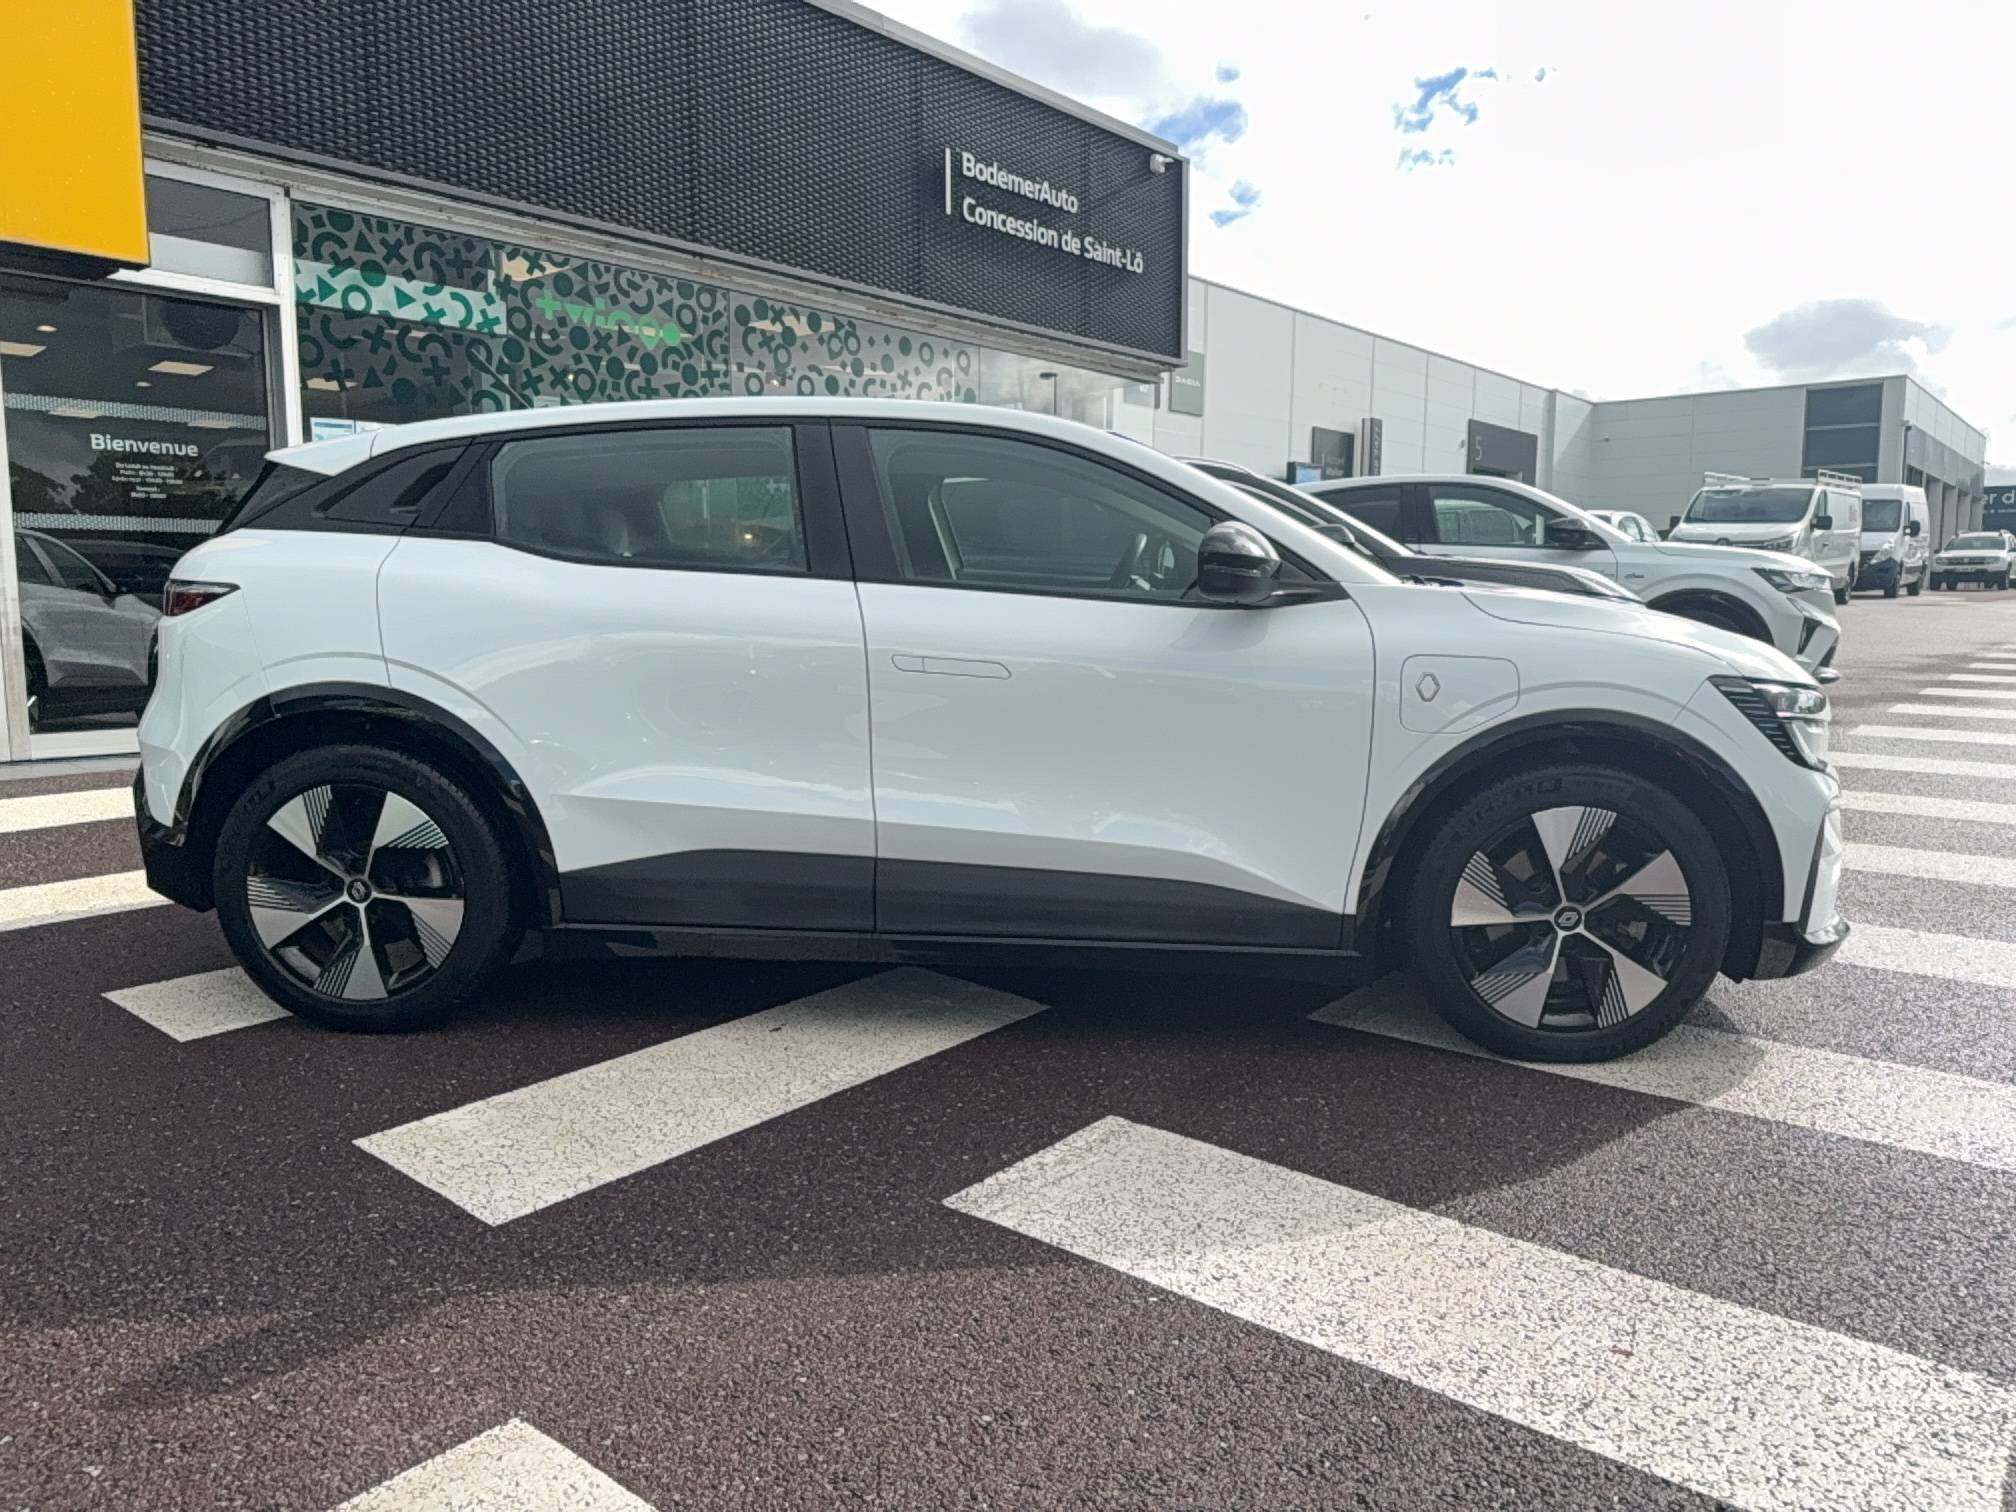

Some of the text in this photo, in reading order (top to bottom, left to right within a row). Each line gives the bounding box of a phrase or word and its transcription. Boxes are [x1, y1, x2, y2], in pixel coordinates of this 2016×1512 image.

[961, 152, 1079, 214] BodemerAuto
[963, 196, 1144, 274] Concession de Saint-Lô
[89, 433, 199, 457] Bienvenue
[1475, 435, 1482, 461] 5
